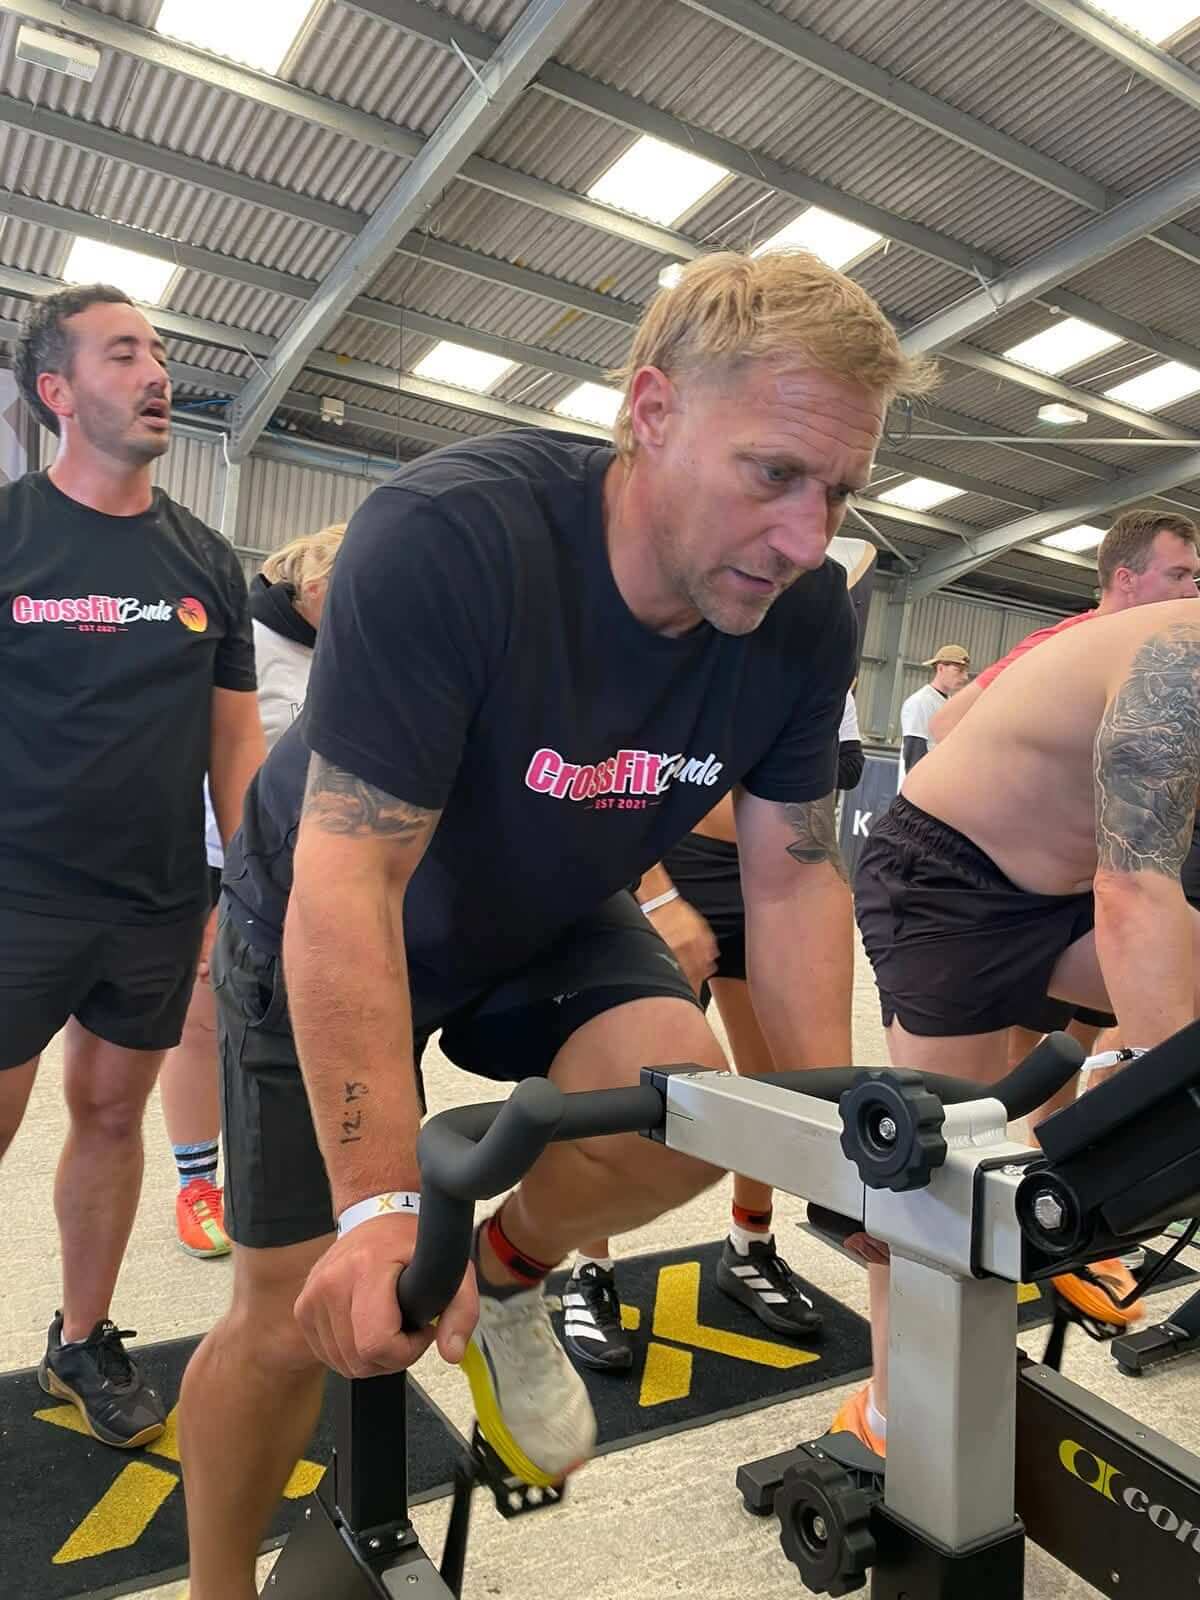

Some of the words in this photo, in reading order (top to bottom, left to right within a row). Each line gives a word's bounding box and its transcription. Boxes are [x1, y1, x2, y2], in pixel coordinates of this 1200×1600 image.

[13, 595, 123, 623] CrossFit
[525, 748, 662, 801] CrossFit
[617, 799, 647, 809] 2021
